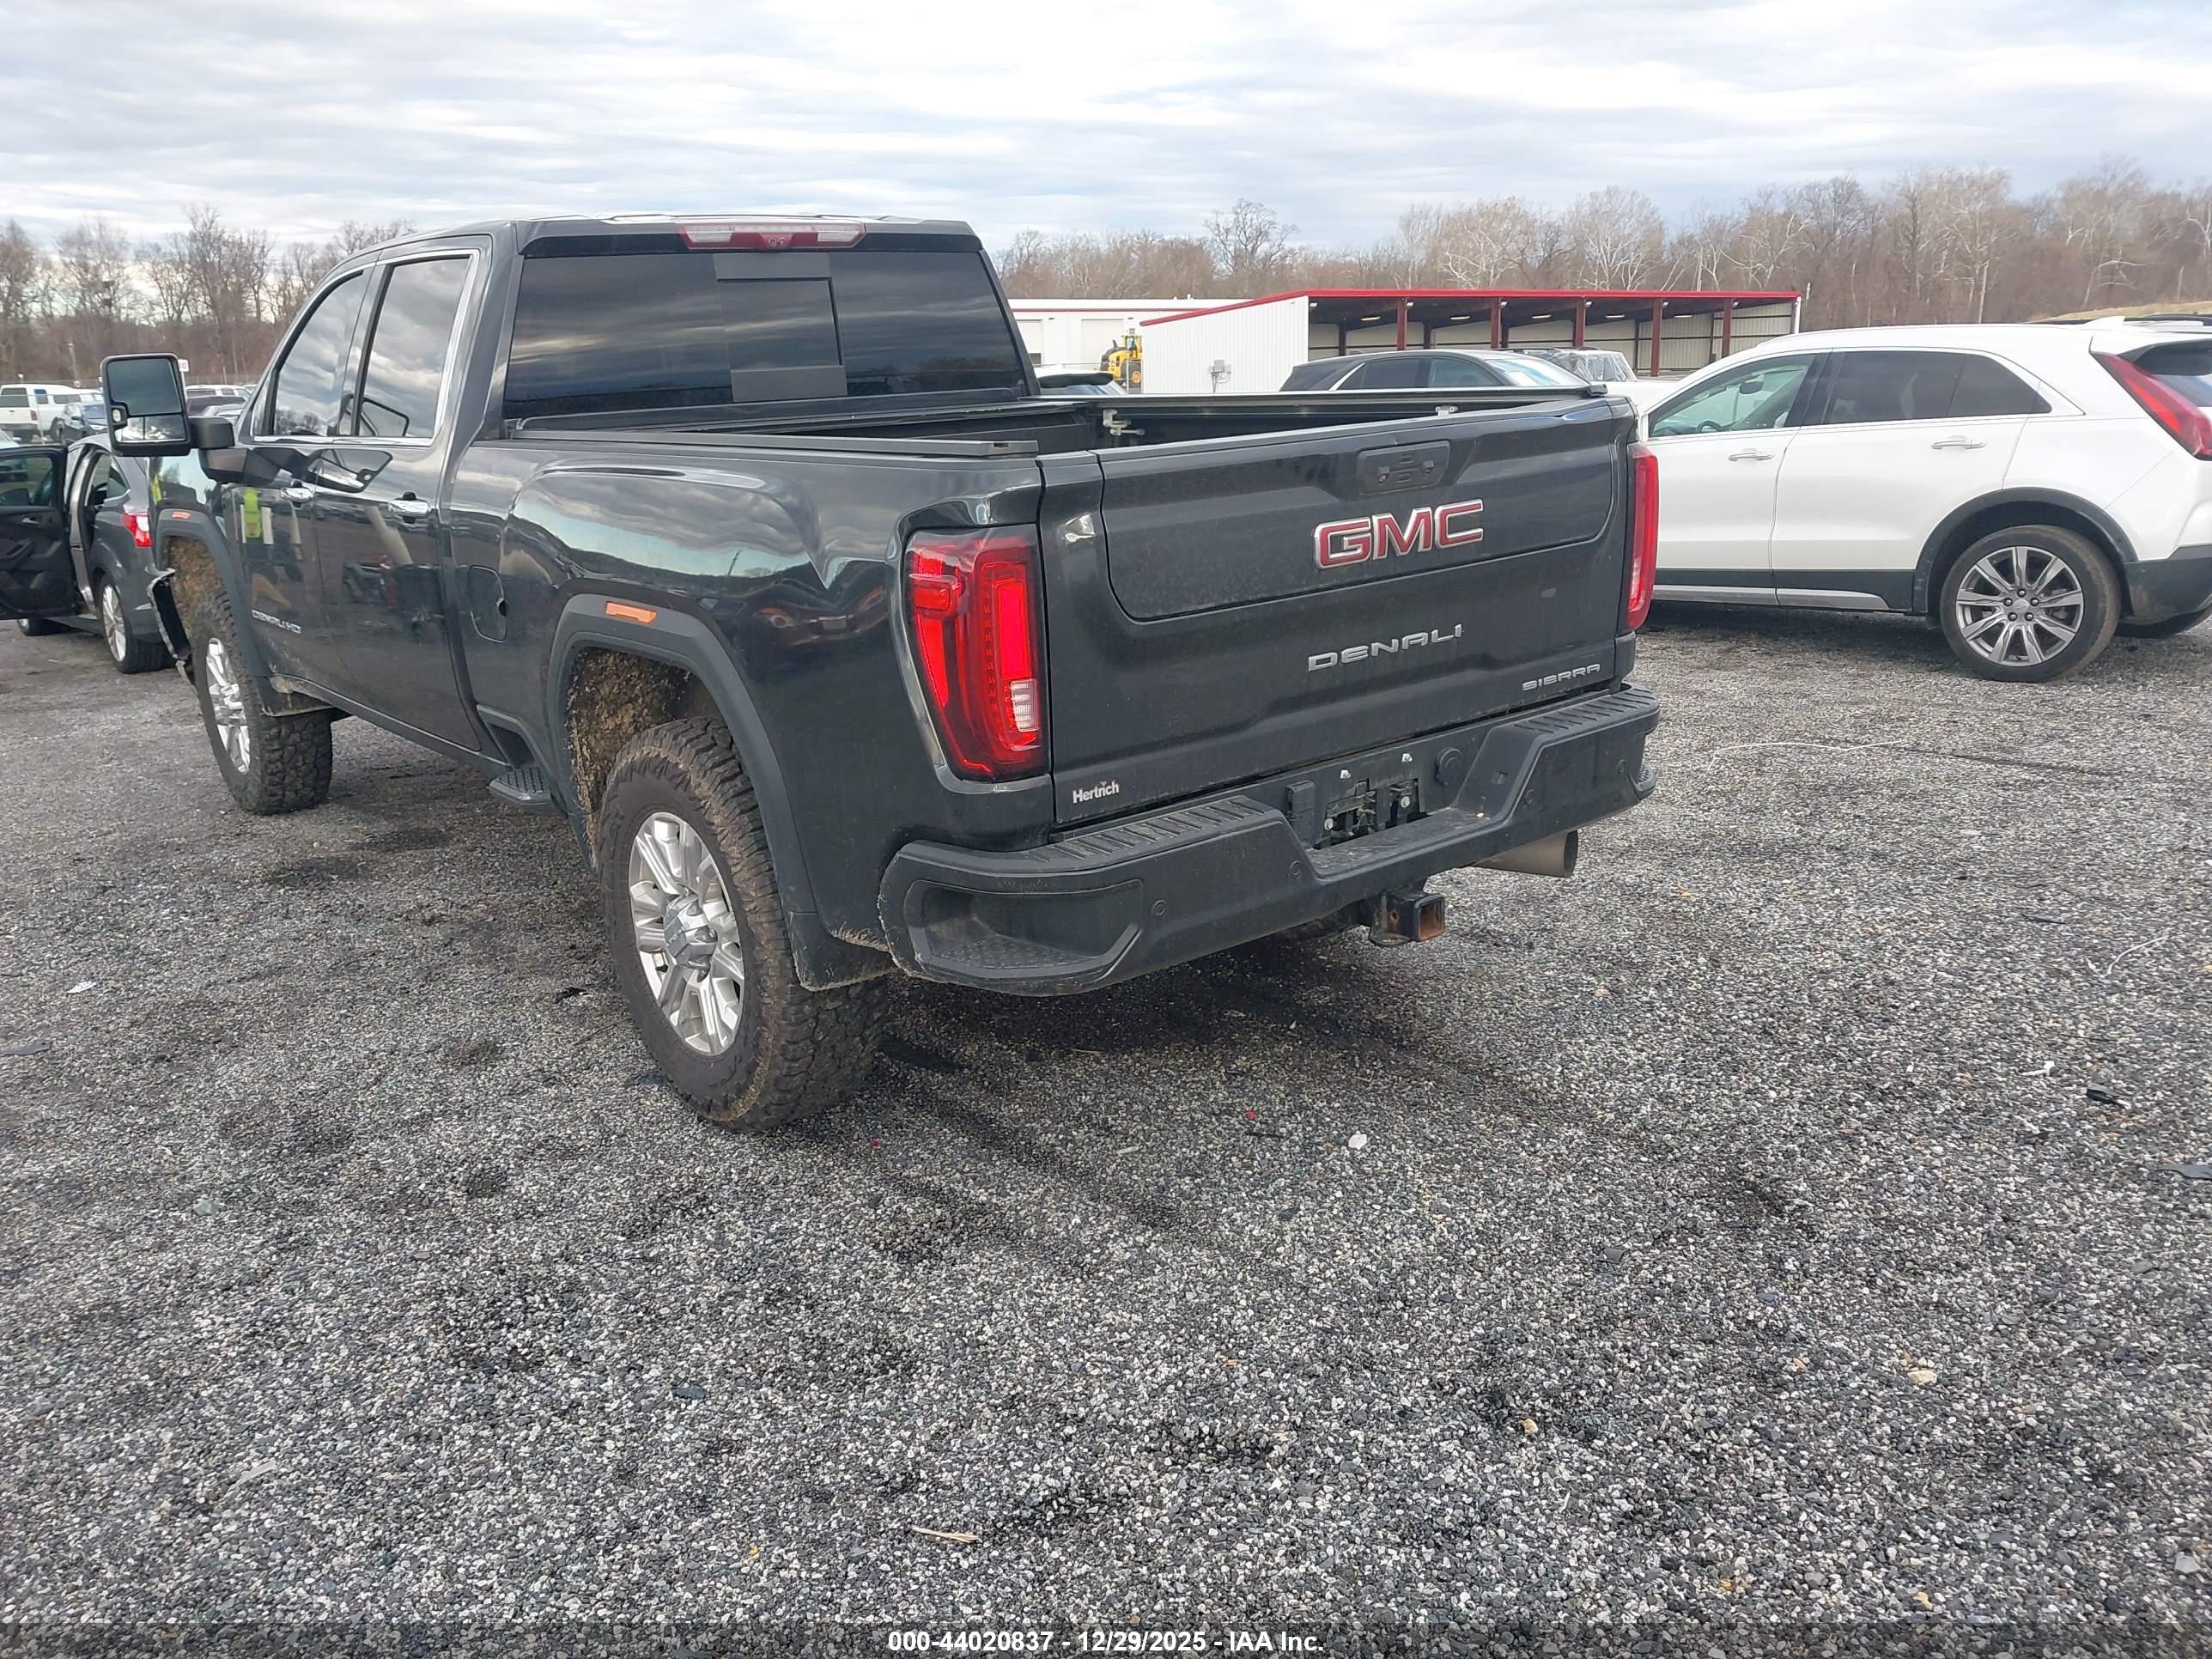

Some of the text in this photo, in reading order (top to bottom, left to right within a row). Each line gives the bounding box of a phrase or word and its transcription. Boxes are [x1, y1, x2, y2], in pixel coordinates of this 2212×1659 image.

[1315, 498, 1484, 569] GMC
[1308, 623, 1462, 672] DENALI
[1522, 663, 1601, 691] SIERRA
[1073, 781, 1120, 804] Hertrich
